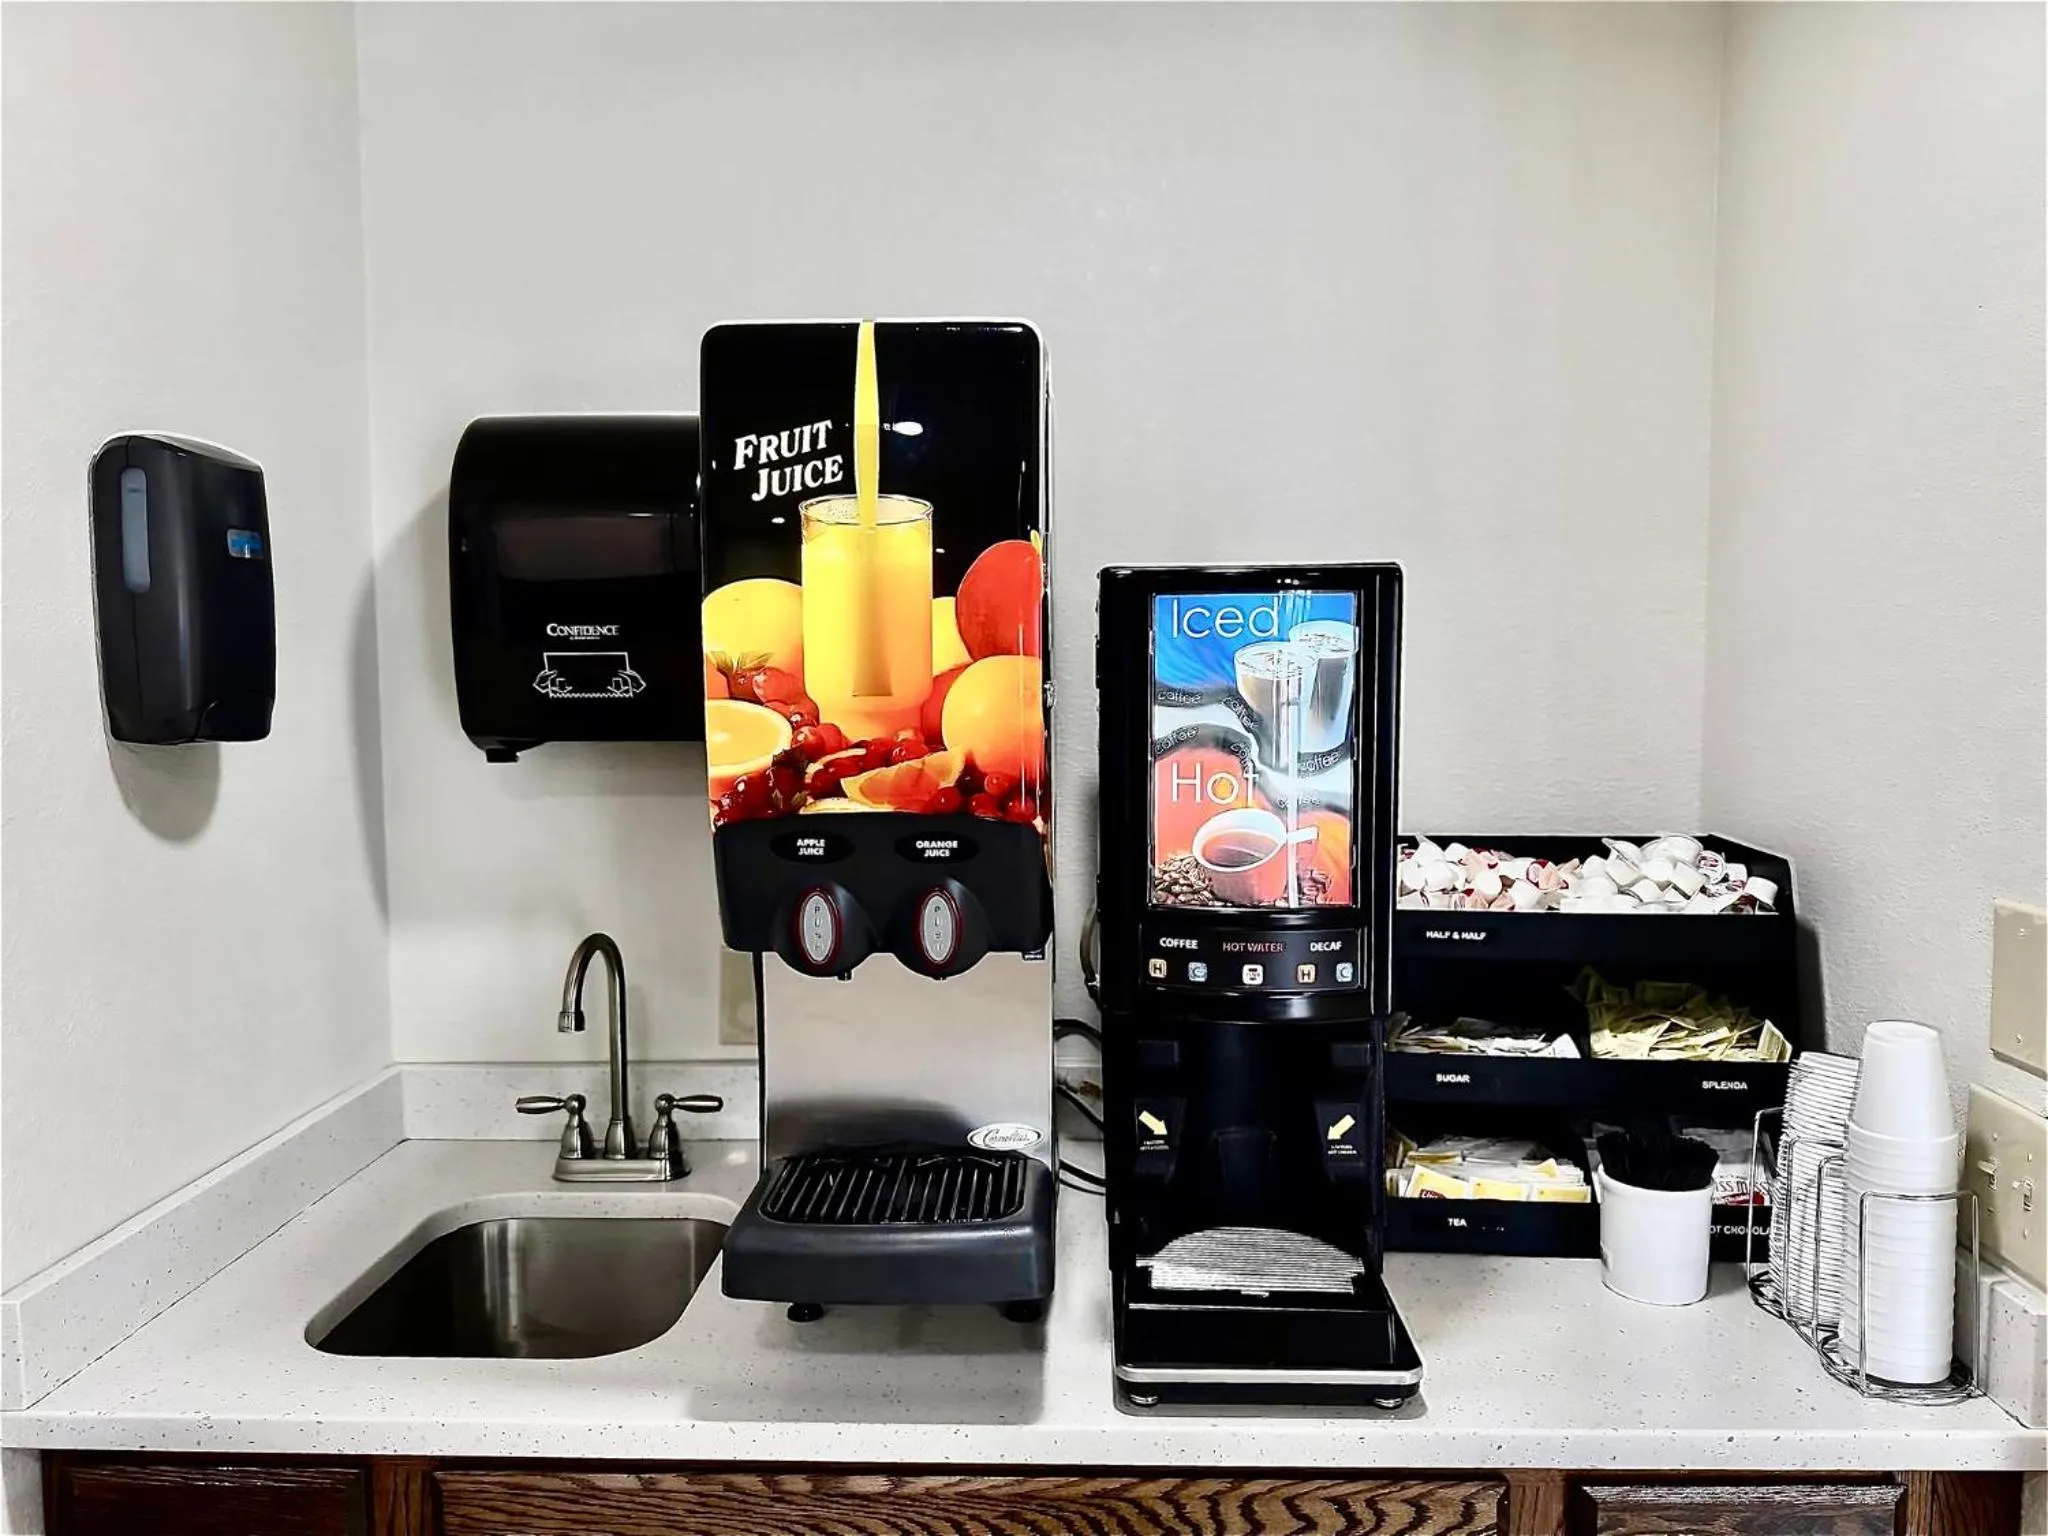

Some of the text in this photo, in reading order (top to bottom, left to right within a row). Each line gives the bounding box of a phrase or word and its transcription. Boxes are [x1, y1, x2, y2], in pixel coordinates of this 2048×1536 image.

[733, 419, 833, 471] FRUIT
[751, 454, 844, 502] JUICE
[1172, 595, 1280, 639] Iced
[546, 623, 620, 637] CONFIDENCE
[1172, 760, 1260, 806] Hot
[796, 838, 826, 848] APPLE
[915, 840, 958, 849] ORANGE
[798, 847, 825, 856] JUICE
[924, 849, 951, 858] JUICE
[1426, 930, 1487, 940] HALF & HALF
[1159, 937, 1199, 949] COFFEE
[1222, 942, 1284, 952] HOT WATER
[1310, 941, 1343, 952] DECAF
[1435, 1073, 1471, 1084] SUGAR
[1701, 1080, 1748, 1090] SPLENDA
[1447, 1217, 1468, 1228] TEA
